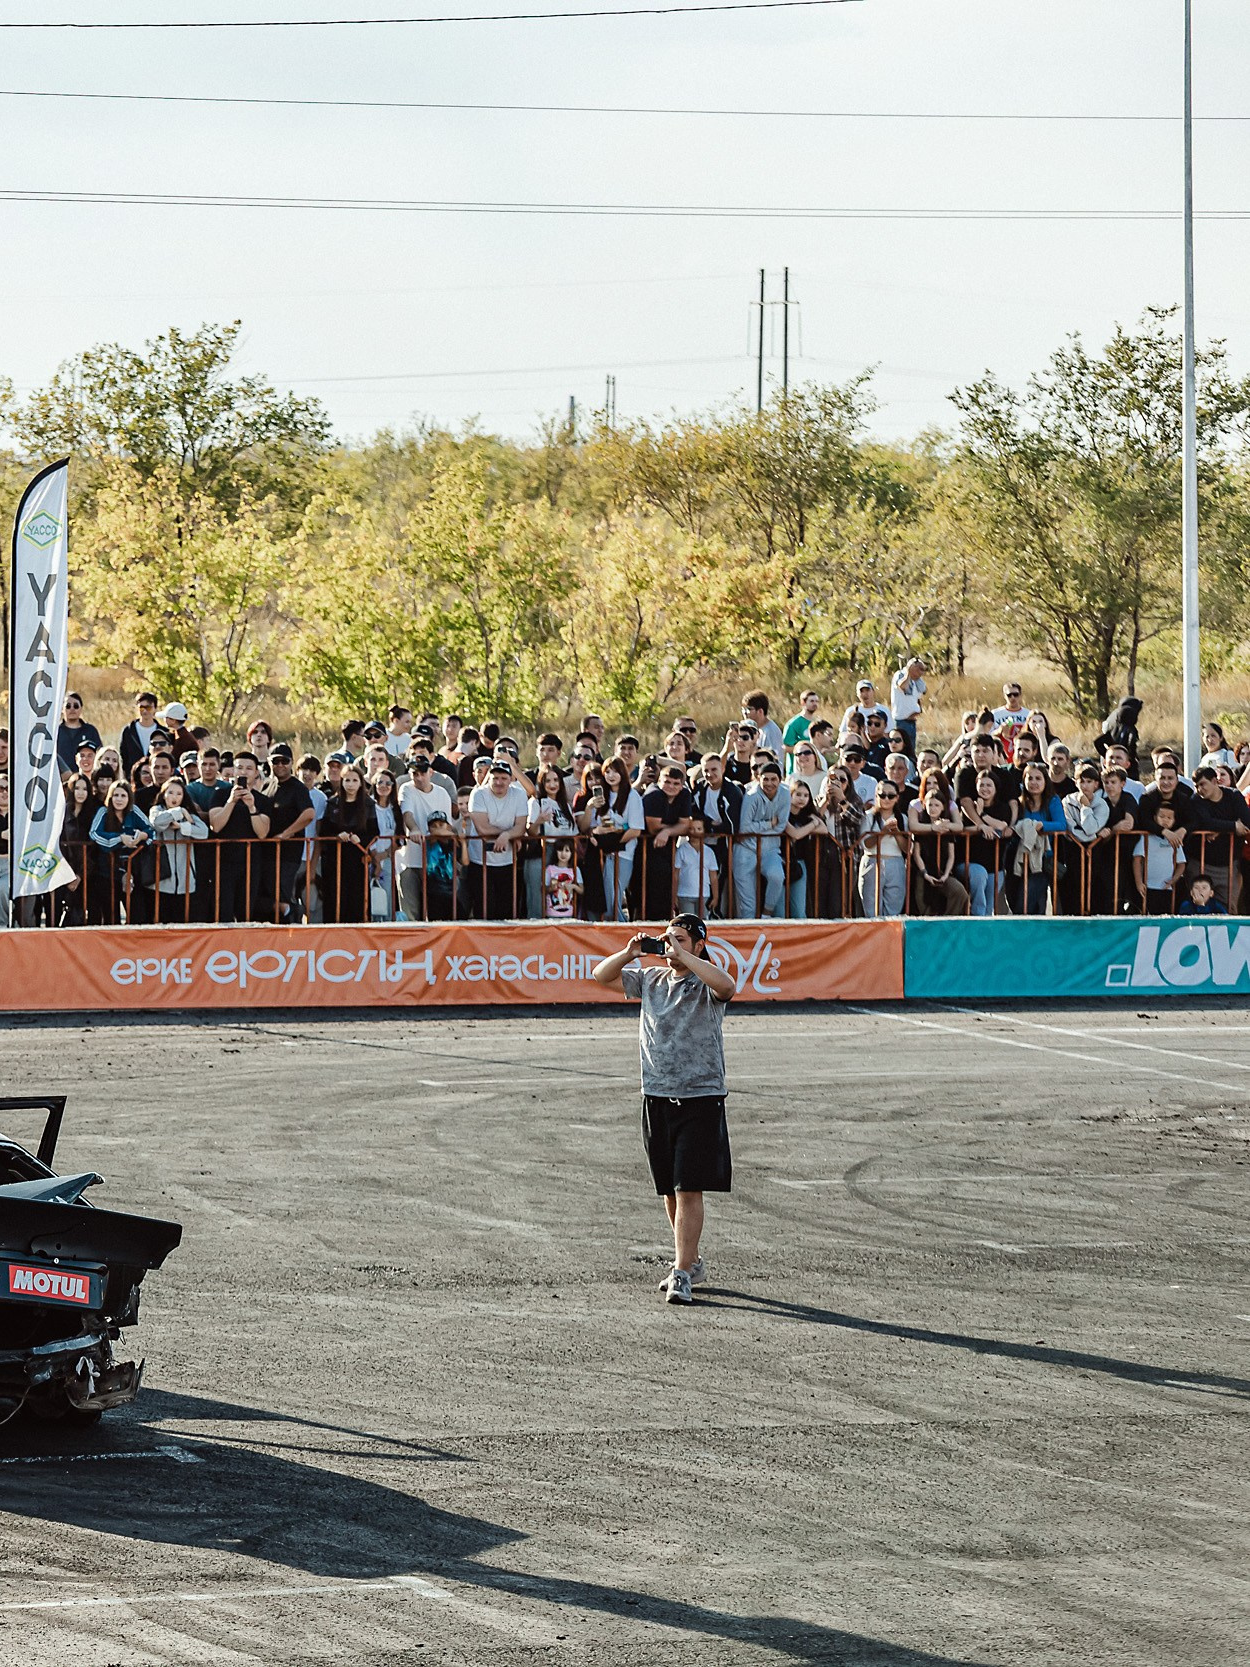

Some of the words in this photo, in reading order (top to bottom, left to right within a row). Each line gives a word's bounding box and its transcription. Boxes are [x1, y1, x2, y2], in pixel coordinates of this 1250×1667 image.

[27, 525, 57, 536] YACCO
[25, 572, 57, 822] YACCO
[13, 1269, 86, 1299] MOTUL
